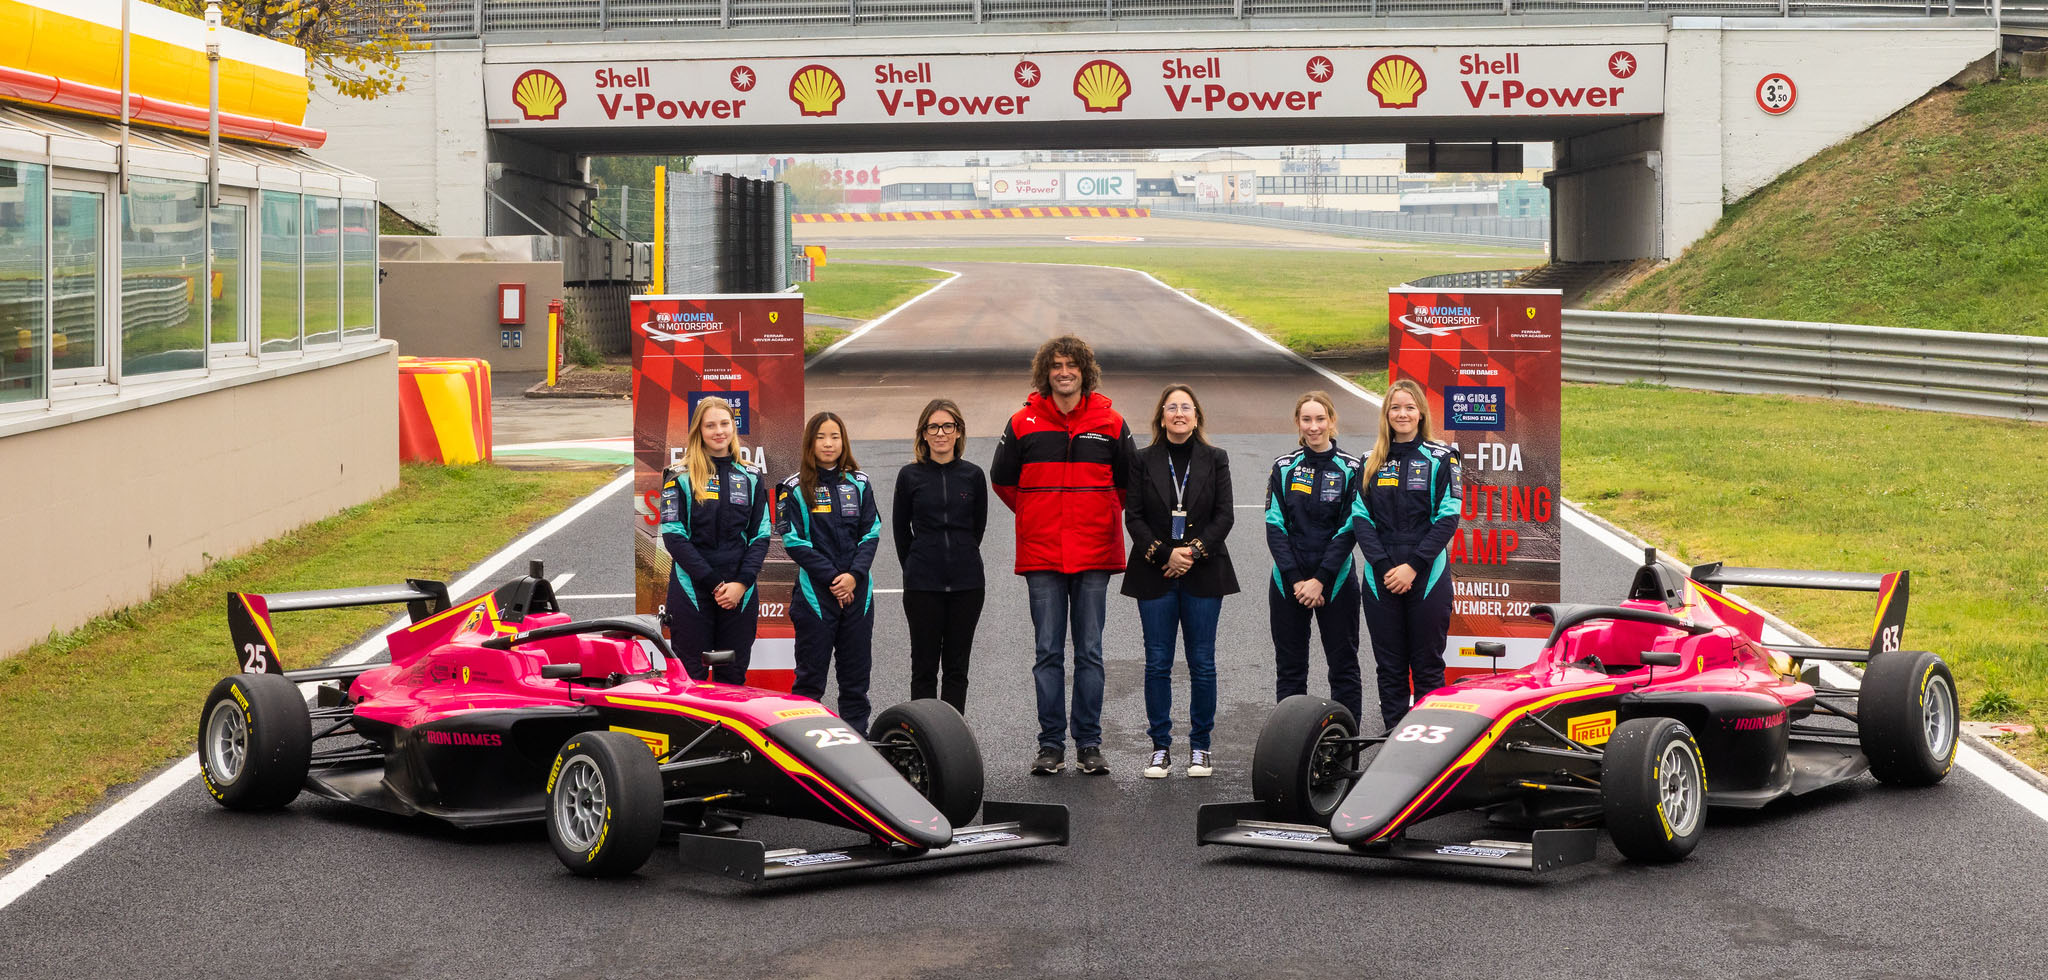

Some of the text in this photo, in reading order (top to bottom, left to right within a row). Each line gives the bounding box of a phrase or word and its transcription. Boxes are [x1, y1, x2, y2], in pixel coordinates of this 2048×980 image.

[875, 63, 931, 83] Shell
[1163, 58, 1220, 78] Shell
[1460, 53, 1519, 74] Shell
[596, 68, 650, 88] Shell
[878, 89, 1030, 116] V-Power
[1165, 84, 1322, 111] V-Power
[1462, 81, 1625, 108] V-Power
[598, 94, 746, 120] V-Power
[656, 312, 714, 322] FIA WOMEN
[1414, 306, 1472, 316] FIA WOMEN
[1424, 316, 1481, 325] MOTORSPORT
[666, 321, 724, 331] MOTORSPORT
[1453, 393, 1498, 403] FIA GIRLS
[1461, 485, 1552, 522] UTING
[1450, 528, 1519, 565] AMP
[1452, 582, 1510, 597] ARANELLO
[1882, 625, 1900, 653] 83
[244, 643, 267, 674] 25
[1572, 718, 1611, 743] PIRELLI
[1734, 717, 1765, 730] IRON
[427, 730, 502, 747] IRON DAMES
[805, 727, 861, 749] 25
[1394, 724, 1454, 744] 83
[546, 753, 563, 794] PIRELLI
